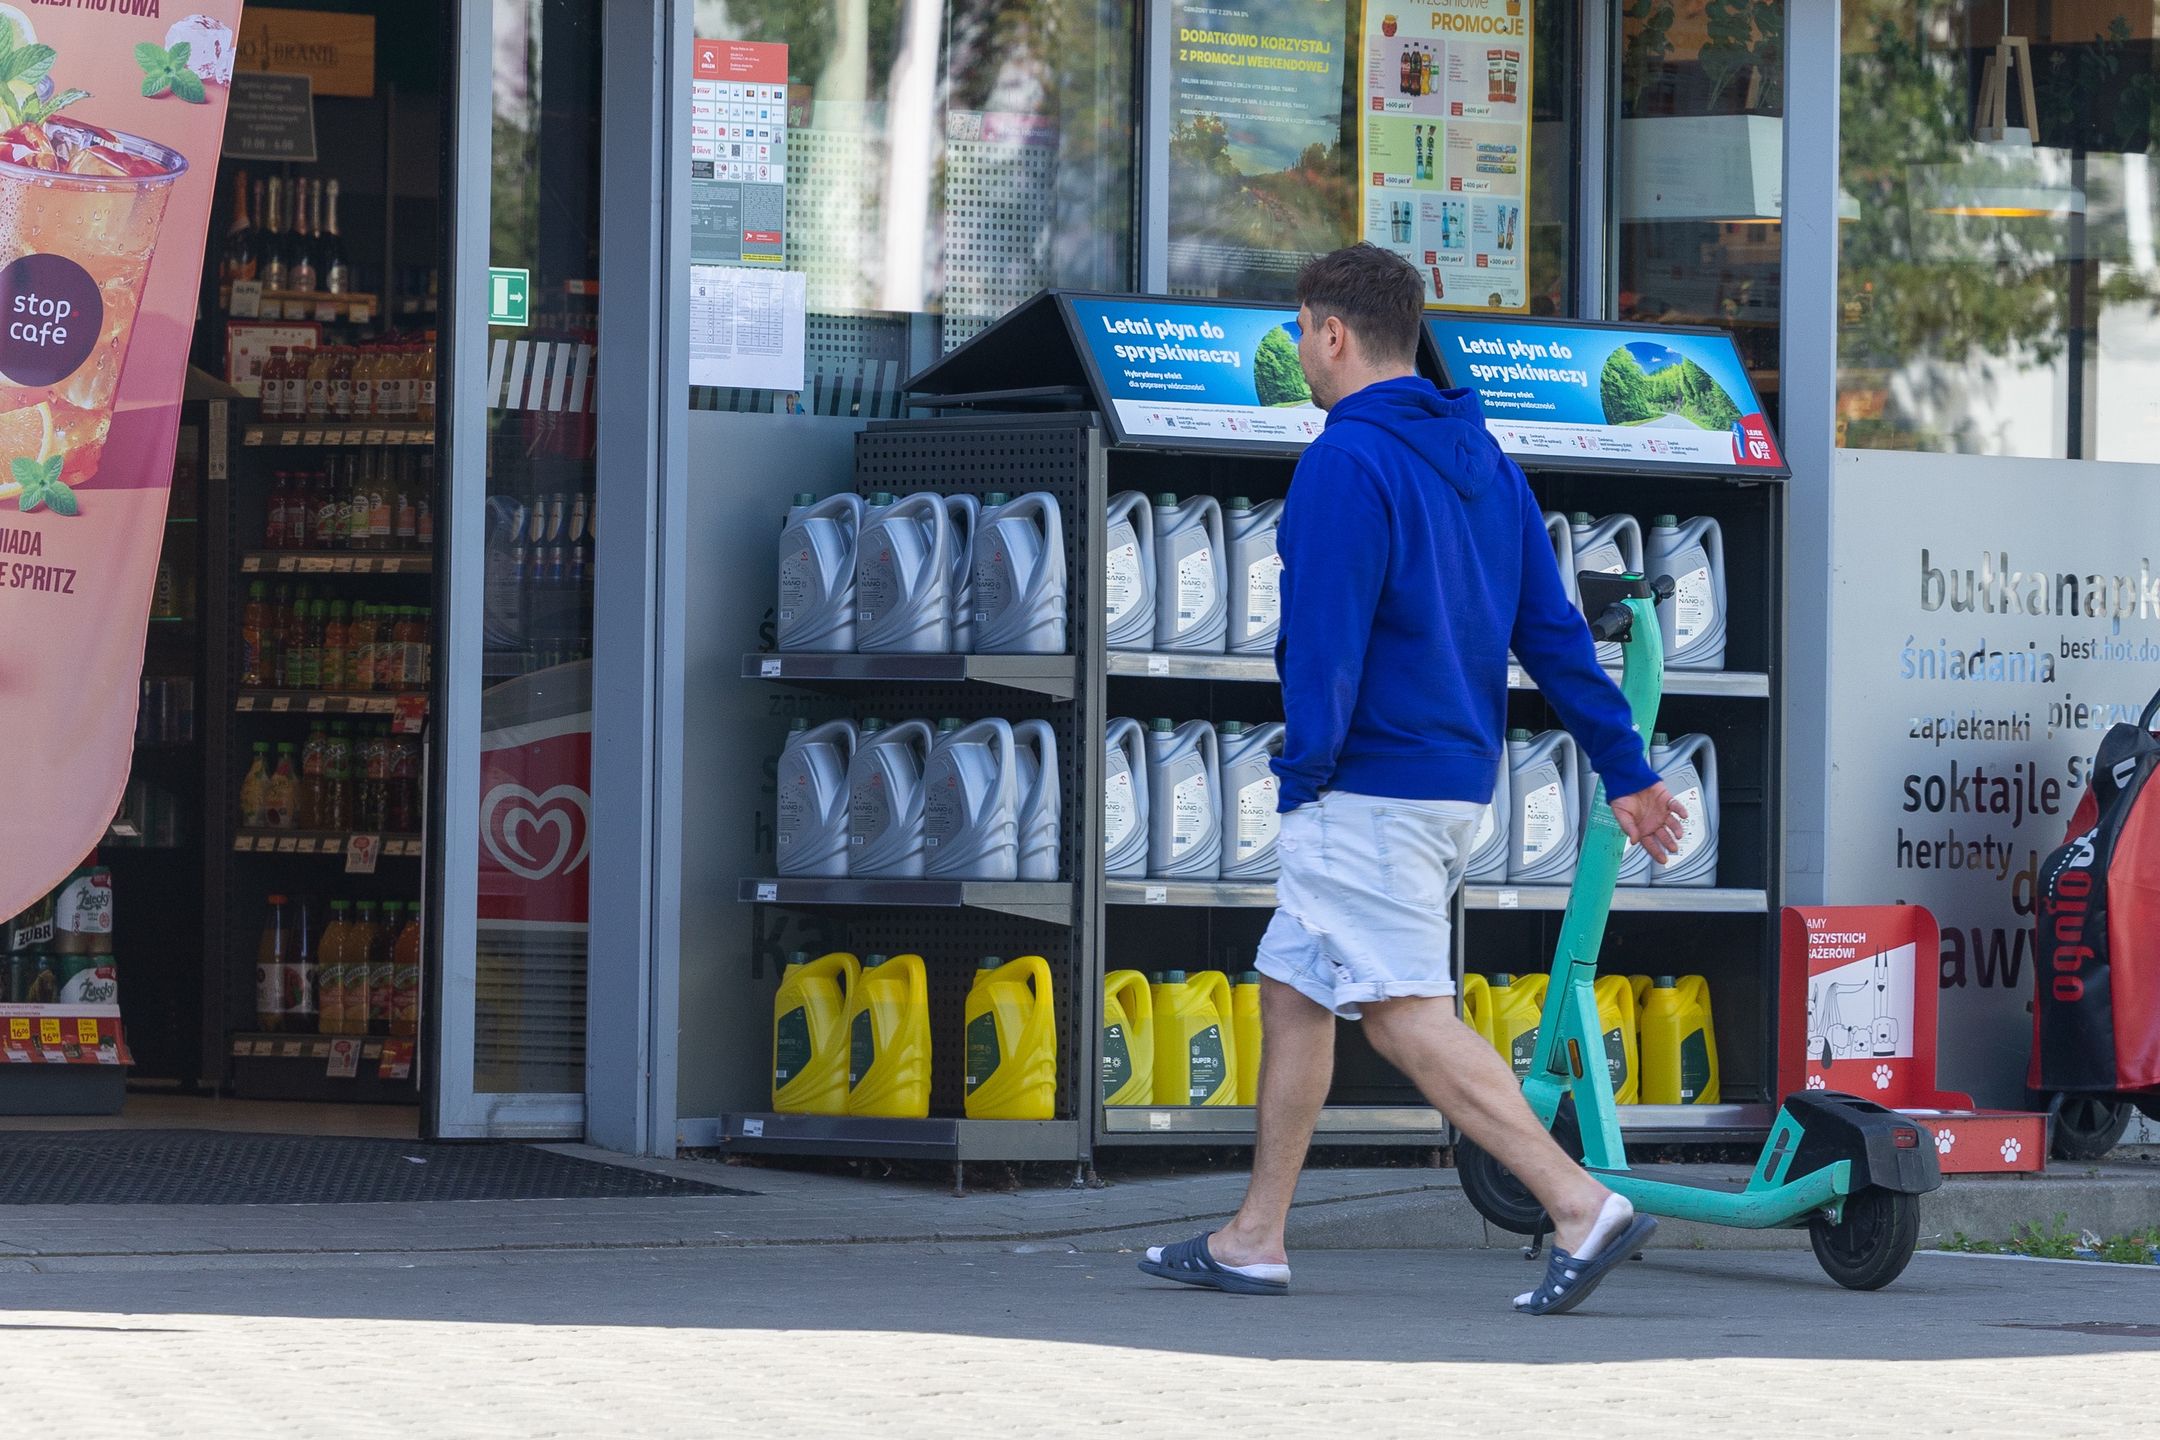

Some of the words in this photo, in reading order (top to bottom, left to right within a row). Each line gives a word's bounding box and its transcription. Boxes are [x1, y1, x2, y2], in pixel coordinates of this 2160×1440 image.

[1431, 12, 1524, 36] PROMOCJE
[1180, 28, 1258, 48] DODATKOWO
[1261, 36, 1331, 54] KORZYSTAJ
[1179, 49, 1187, 61] Z
[1190, 51, 1245, 66] PROMOCJI
[1247, 56, 1329, 73] WEEKENDOWEJ
[13, 293, 71, 323] stop
[10, 319, 67, 347] cafe
[1102, 315, 1154, 336] Letni
[1155, 319, 1198, 341] płyn
[1200, 322, 1224, 340] do
[1113, 343, 1241, 368] spryskiwaczy
[1458, 336, 1506, 356] Letni
[1508, 339, 1547, 360] płyn
[1549, 342, 1572, 359] do
[1124, 369, 1163, 381] Hybrydowy
[1163, 371, 1182, 380] efekt
[1129, 380, 1139, 388] dla
[1140, 382, 1167, 391] poprawy
[1167, 382, 1206, 391] widoczności
[1470, 362, 1588, 387] spryskiwaczy
[1479, 388, 1517, 399] Hybrydowy
[1517, 390, 1534, 399] efekt
[1484, 398, 1494, 407] dla
[1496, 400, 1520, 409] poprawy
[1520, 400, 1556, 410] widoczności
[1749, 440, 1762, 459] 0
[9, 562, 77, 594] SPRITZ
[1900, 634, 2056, 684] śniadania
[1909, 710, 2031, 747] zapiekanki
[2047, 693, 2143, 740] pieczy
[1902, 759, 2061, 829] soktajle
[1897, 827, 2013, 881] herbaty
[1806, 918, 1827, 929] AMY
[1809, 945, 1855, 959] AŻERÓW!
[1939, 926, 2037, 990] aw
[1514, 1057, 1532, 1065] SUPE
